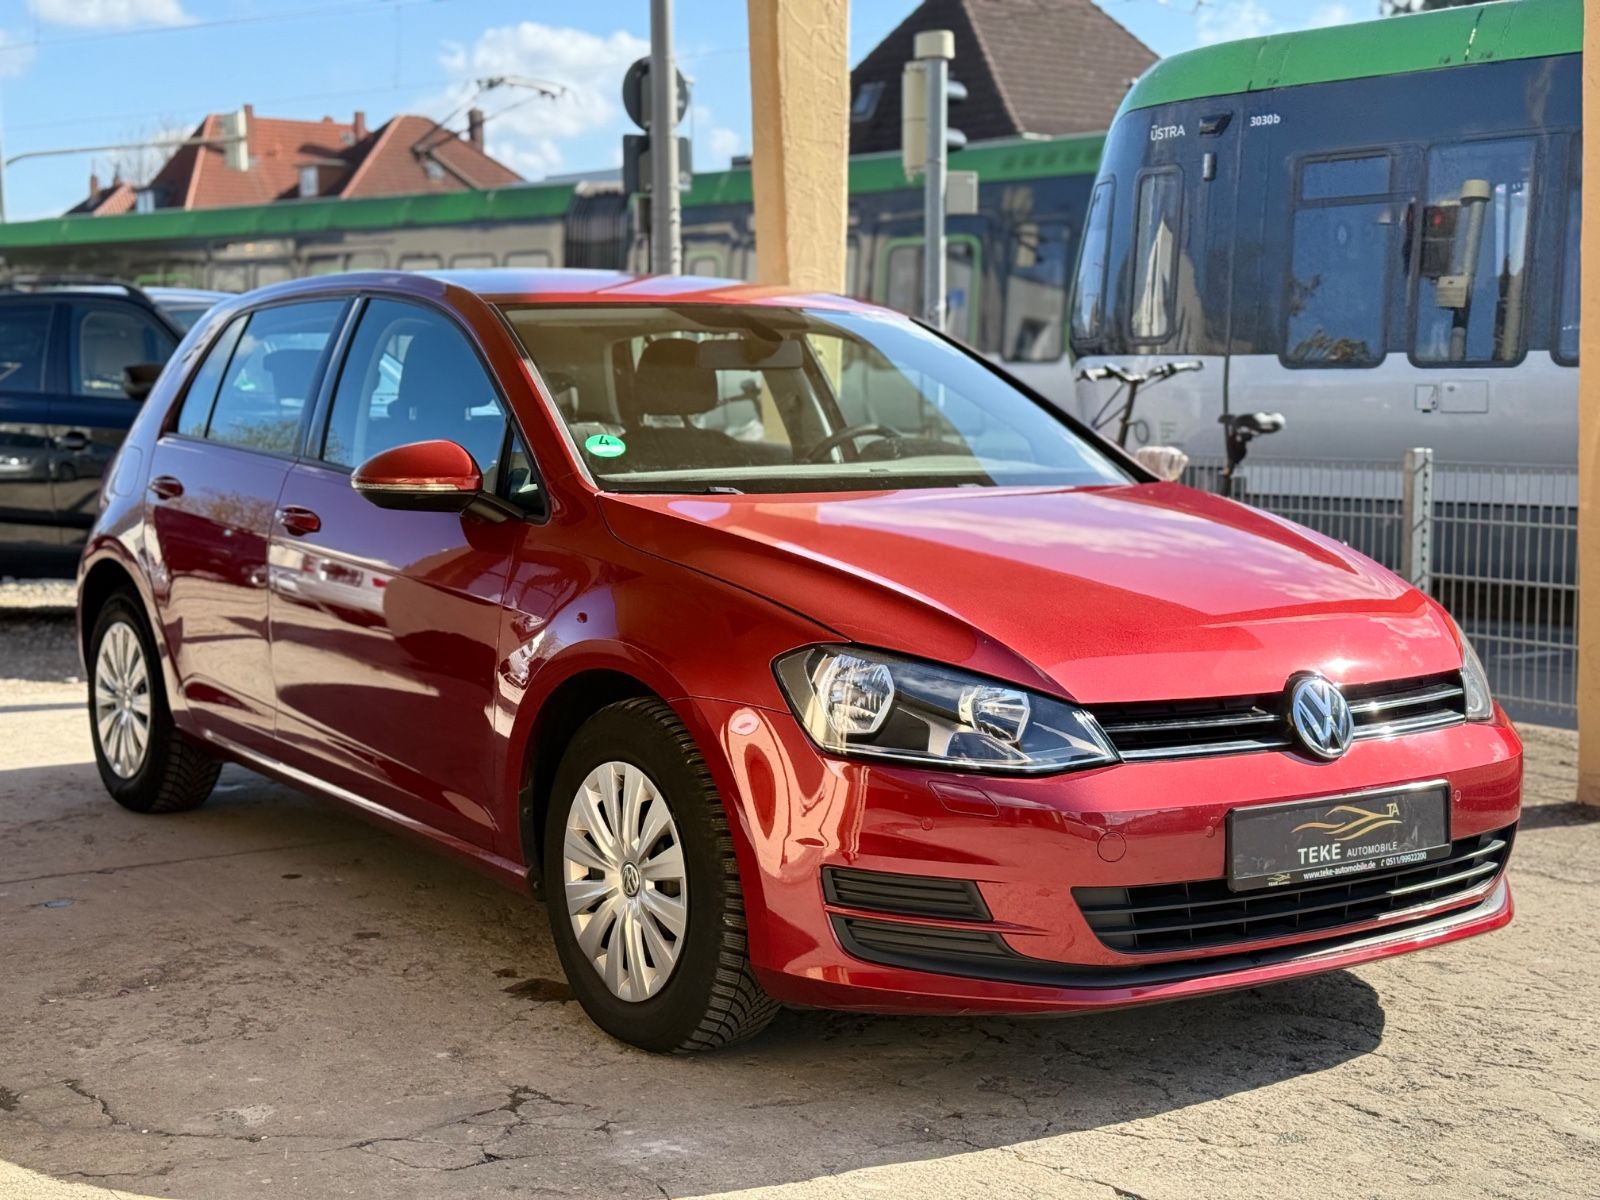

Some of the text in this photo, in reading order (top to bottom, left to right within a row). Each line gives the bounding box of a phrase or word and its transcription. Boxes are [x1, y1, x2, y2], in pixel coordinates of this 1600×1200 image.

[1249, 113, 1281, 127] 3030b
[598, 435, 610, 446] 4
[1294, 680, 1353, 756] VW
[1386, 802, 1400, 817] TA
[1298, 841, 1398, 865] TEKE AUTOMOBILE
[1303, 861, 1376, 880] www.teke-automobile.de
